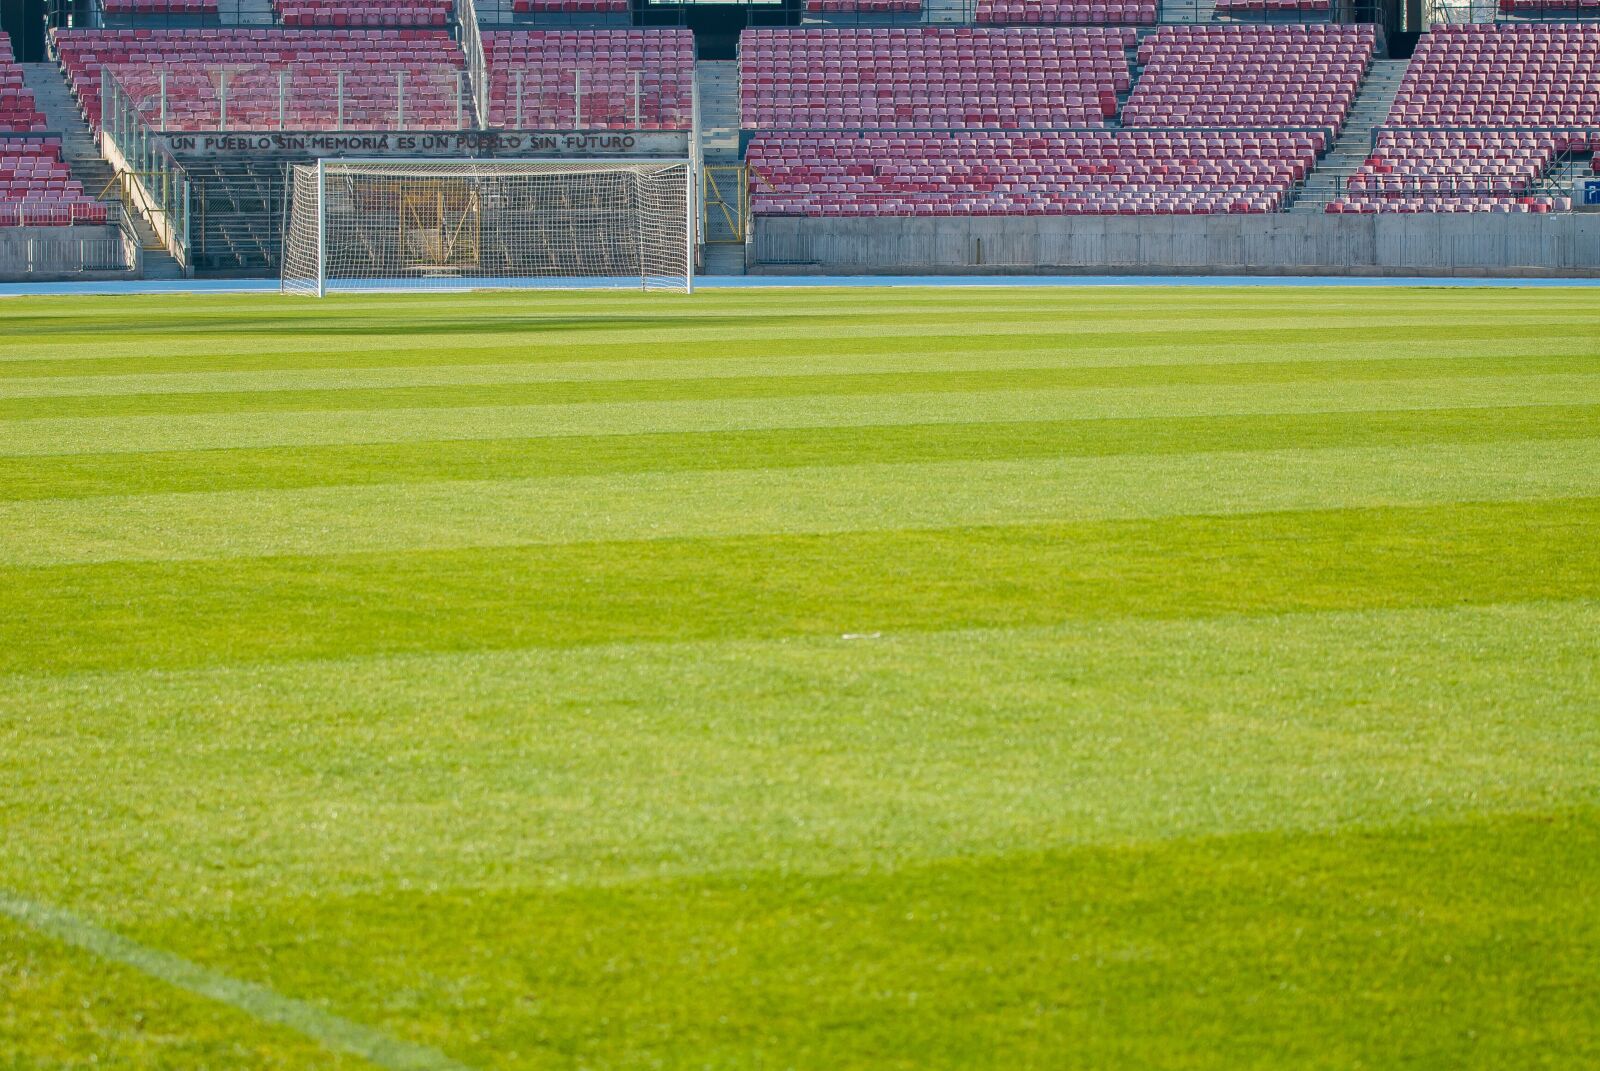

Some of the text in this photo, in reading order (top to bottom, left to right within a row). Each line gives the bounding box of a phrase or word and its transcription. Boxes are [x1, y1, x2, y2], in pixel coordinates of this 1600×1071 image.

[171, 136, 635, 149] UN PUEBLO SIN MEMORIA ES UN PUEBLO SIN FUTURO
